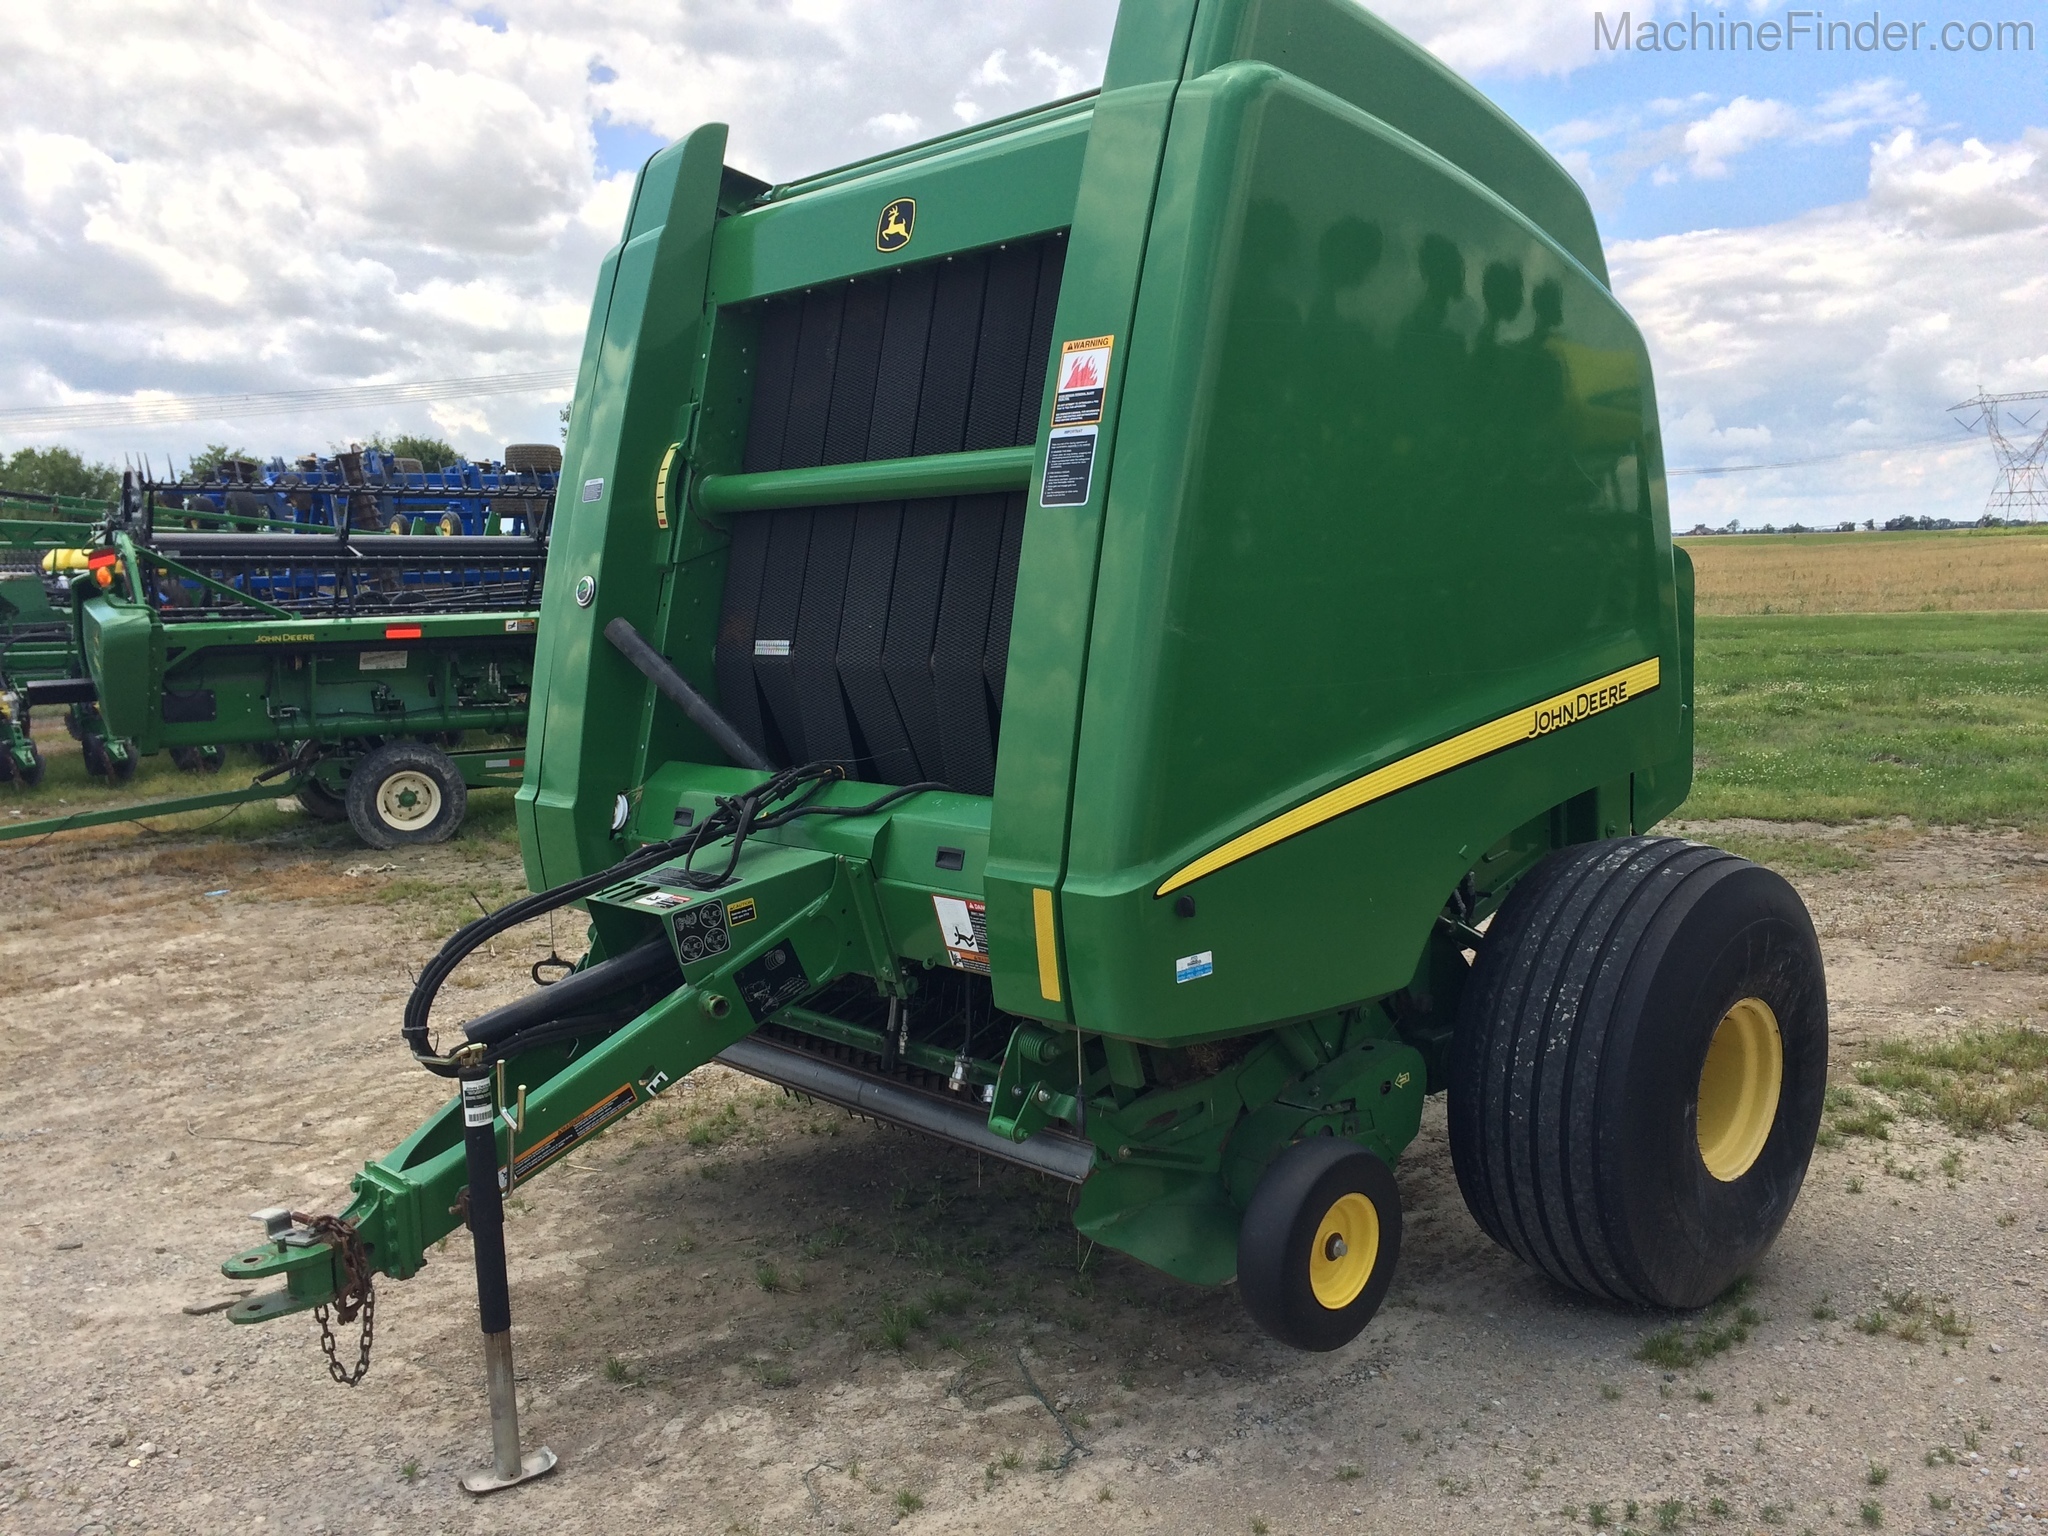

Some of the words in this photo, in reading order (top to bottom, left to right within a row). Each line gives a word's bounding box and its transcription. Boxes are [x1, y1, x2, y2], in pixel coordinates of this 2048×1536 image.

[1073, 337, 1109, 350] WARNING
[254, 634, 282, 643] JOHN
[282, 633, 315, 642] DEERE
[1528, 701, 1574, 736] JOHN
[1576, 680, 1628, 717] DEERE
